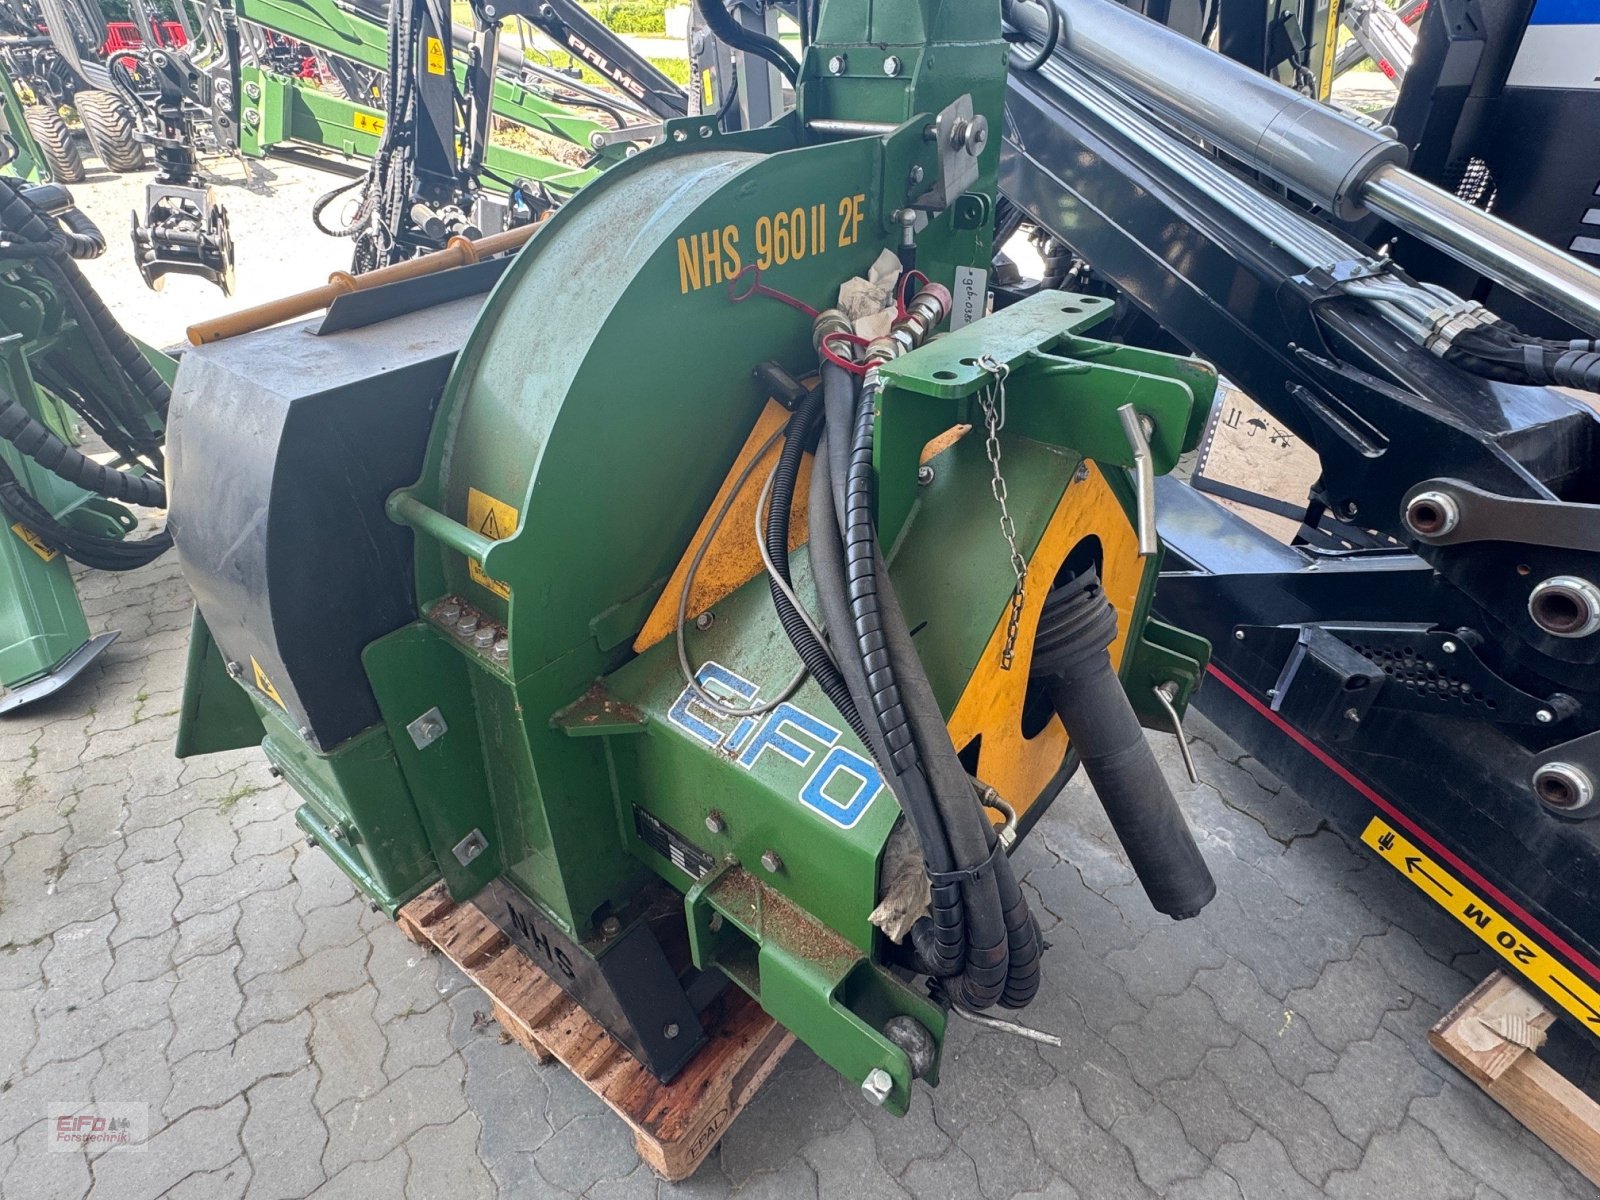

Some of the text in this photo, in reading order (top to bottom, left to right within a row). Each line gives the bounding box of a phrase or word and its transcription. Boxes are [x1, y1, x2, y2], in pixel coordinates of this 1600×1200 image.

[568, 33, 646, 99] PALMS
[677, 224, 742, 294] NHS
[838, 193, 865, 248] 2F
[506, 900, 576, 980] NHS
[1462, 902, 1537, 965] 20 M
[691, 1119, 724, 1159] EPAL
